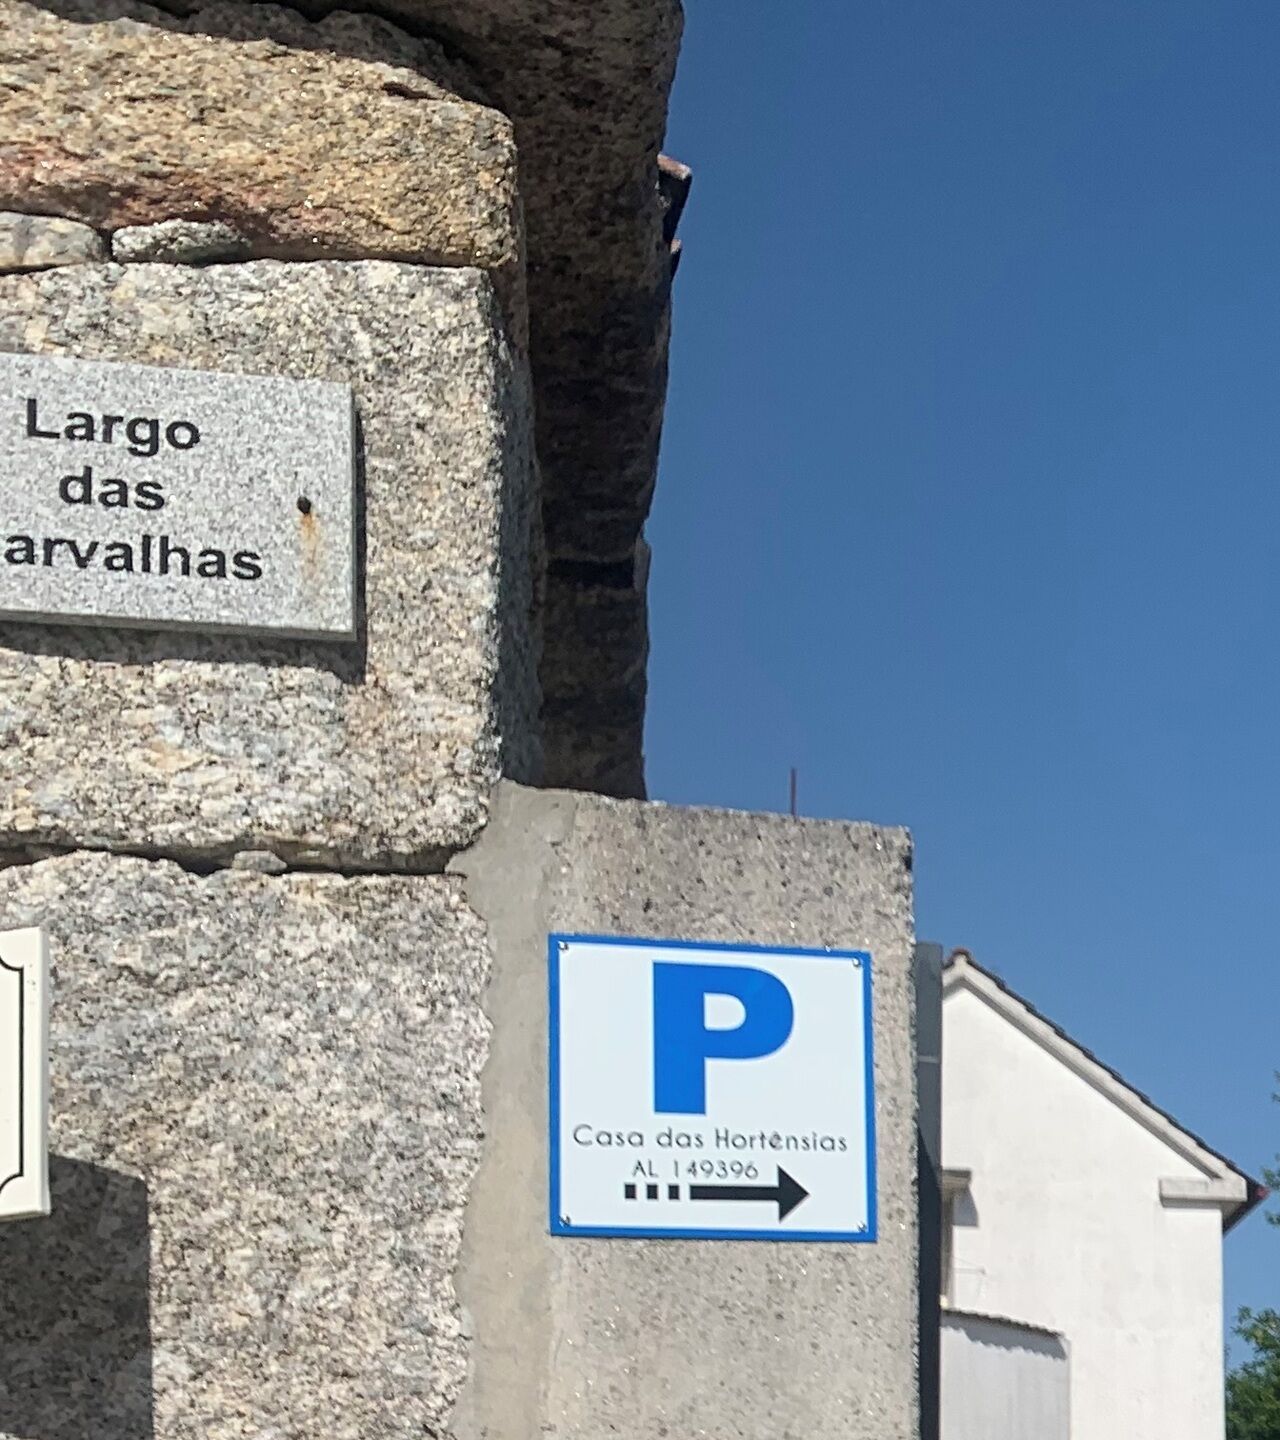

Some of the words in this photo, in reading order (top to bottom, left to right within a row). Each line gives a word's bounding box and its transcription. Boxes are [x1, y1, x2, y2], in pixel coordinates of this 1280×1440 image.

[26, 398, 201, 457] Largo
[59, 466, 165, 511] das
[4, 533, 263, 581] arvalhas
[653, 960, 794, 1115] P
[572, 1123, 644, 1148] Casa
[656, 1127, 704, 1149] das
[715, 1127, 848, 1152] Hortênsias
[632, 1159, 658, 1178] AL
[673, 1159, 759, 1180] 149396
